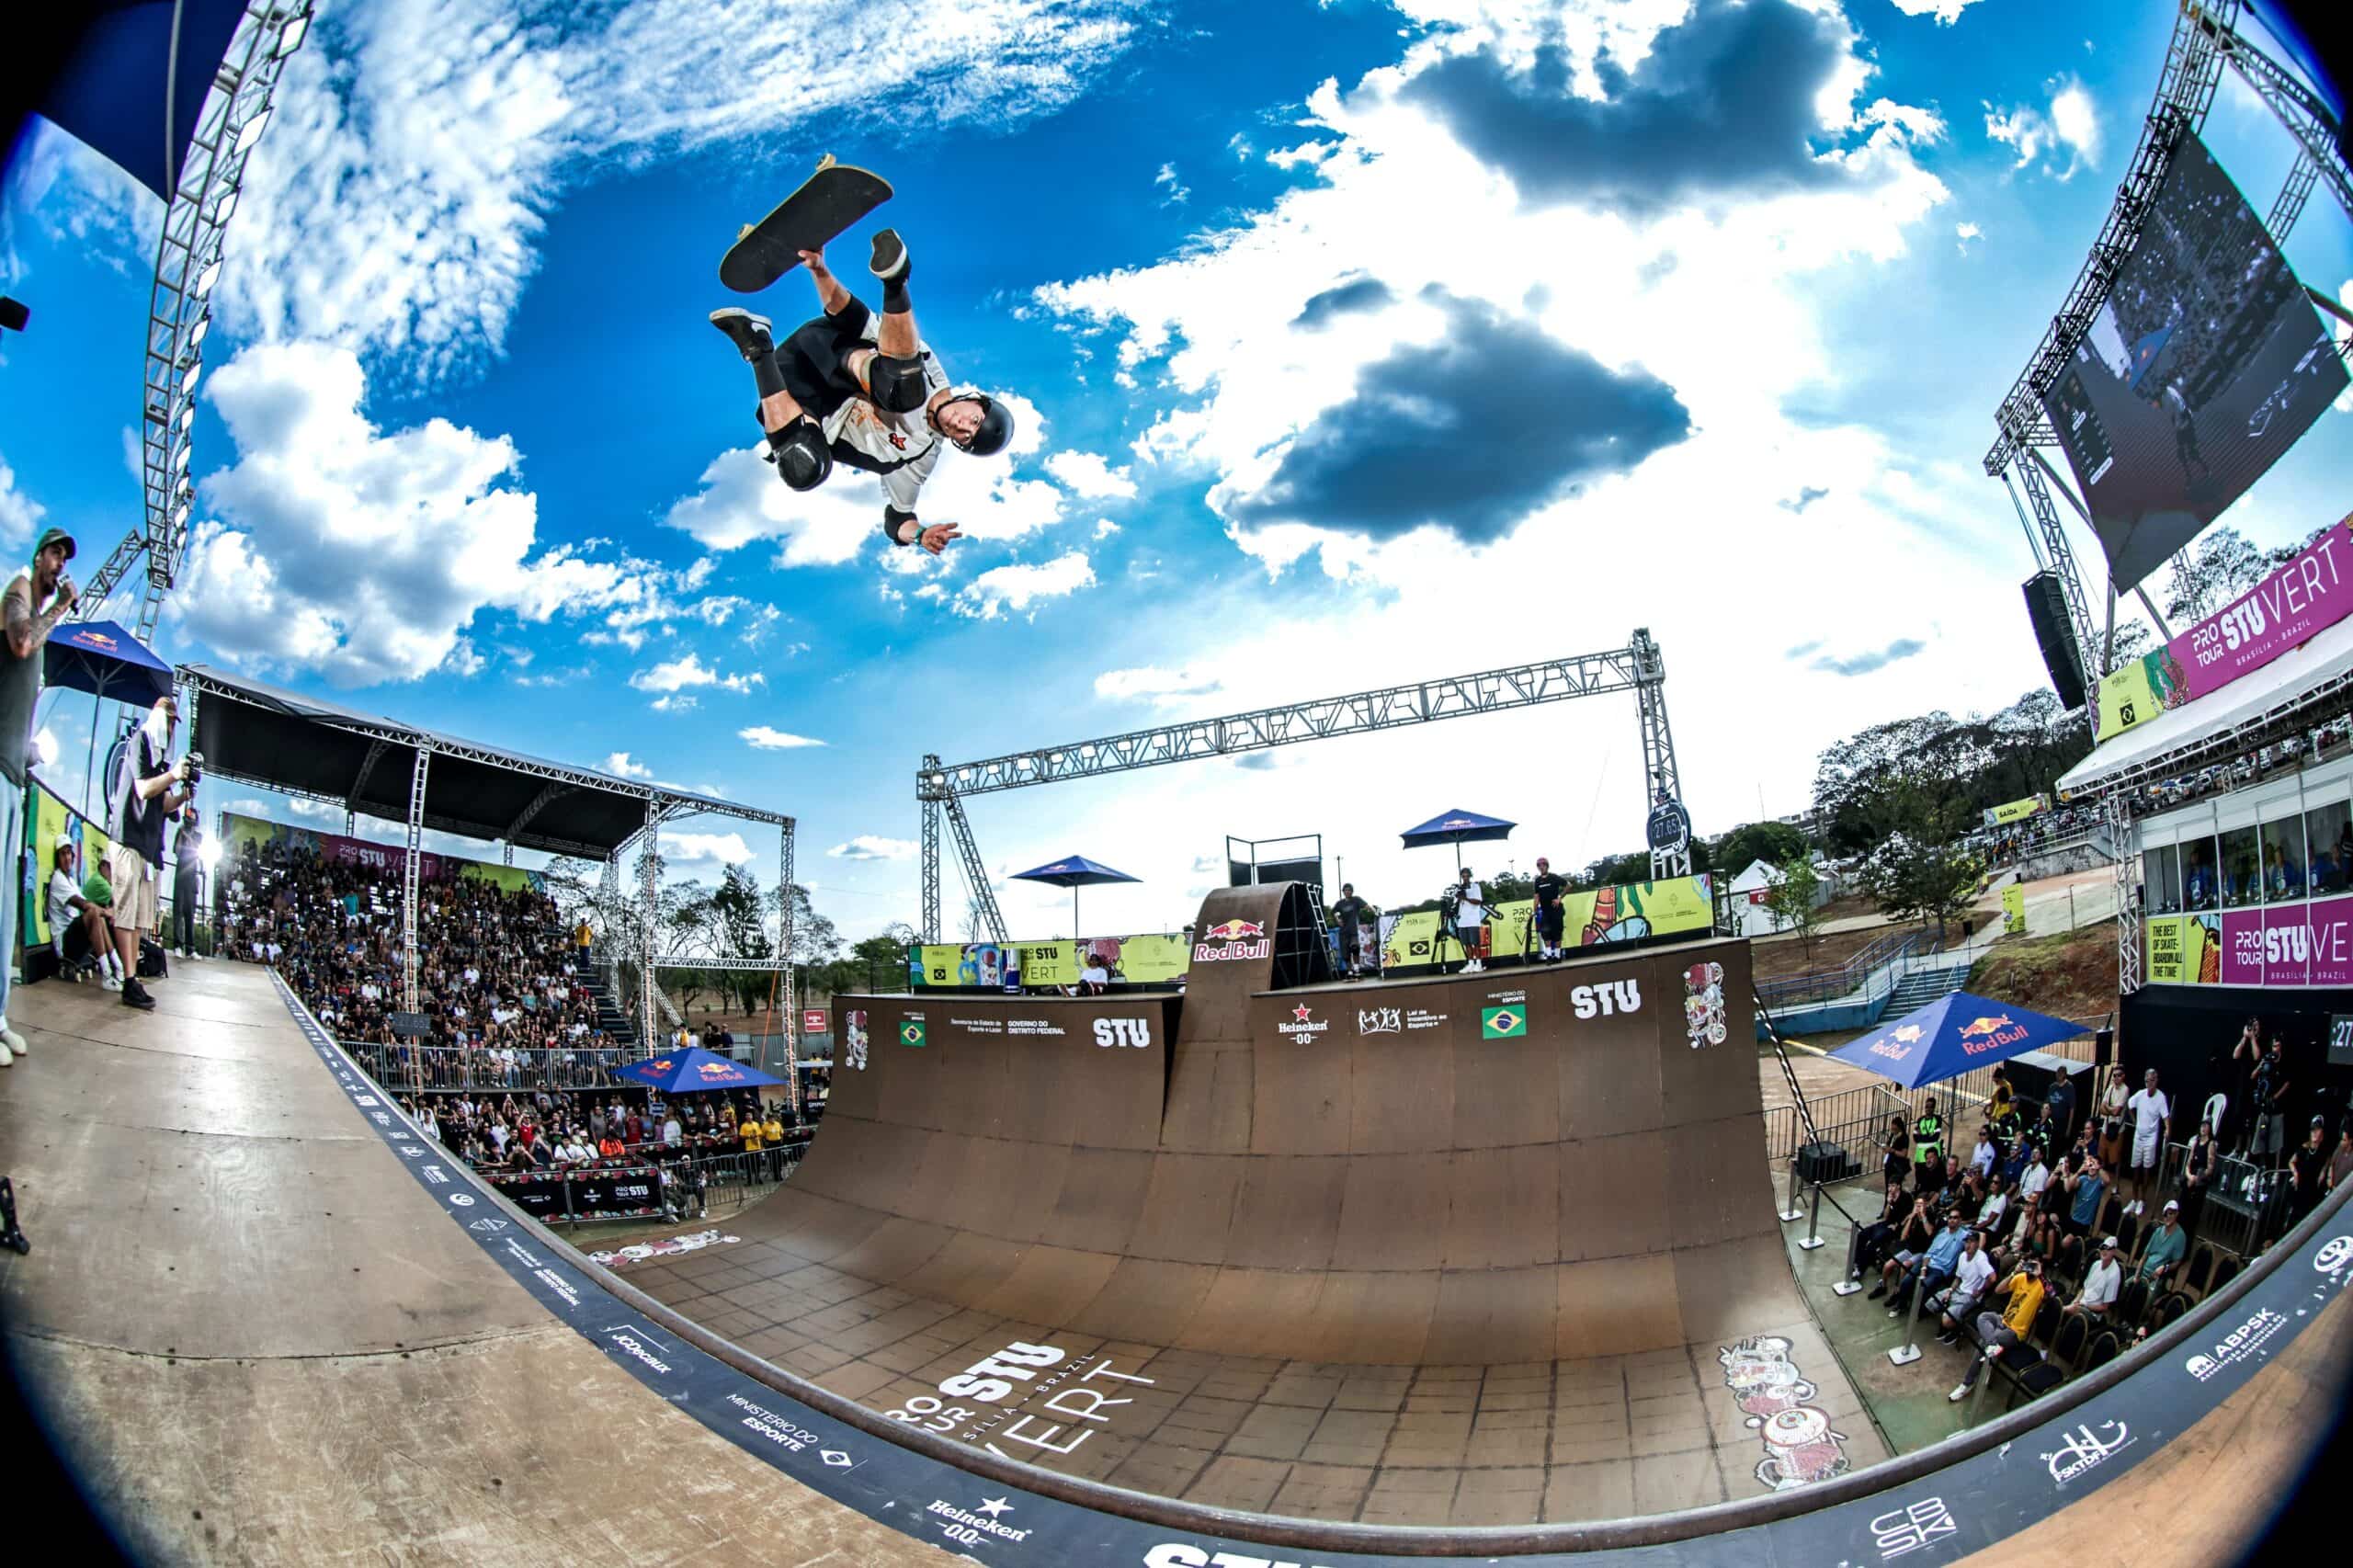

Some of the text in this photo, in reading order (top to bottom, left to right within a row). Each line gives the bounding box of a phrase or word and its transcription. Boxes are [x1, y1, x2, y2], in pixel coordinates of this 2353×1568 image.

[2191, 538, 2338, 652] PRO STU VERT
[2281, 619, 2311, 641] BRAZIL
[2197, 643, 2224, 667] TOUR
[359, 848, 385, 868] STU
[1513, 907, 1532, 917] PRO
[2154, 925, 2177, 937] THE BEST
[2235, 922, 2353, 963] PRO STU VE
[1036, 947, 1058, 960] STU
[1193, 938, 1270, 962] Red Bull
[2235, 951, 2263, 965] TOUR
[2317, 971, 2346, 980] BRAZIL
[1571, 979, 1642, 1019] STU
[1093, 1017, 1151, 1048] STU
[1279, 1021, 1328, 1033] Heineken
[1961, 1025, 2029, 1056] Red Bull
[630, 1185, 648, 1196] STU
[2215, 1307, 2275, 1358] ABPSK
[611, 1334, 672, 1374] JCDecaux
[884, 1341, 1066, 1423] RO STU
[962, 1353, 1096, 1441] SÍLIA BRAZIL
[726, 1393, 818, 1444] MINISTÉRIO DO
[920, 1407, 975, 1434] UR
[742, 1416, 807, 1452] ESPORTE
[926, 1499, 1028, 1542] Heineken
